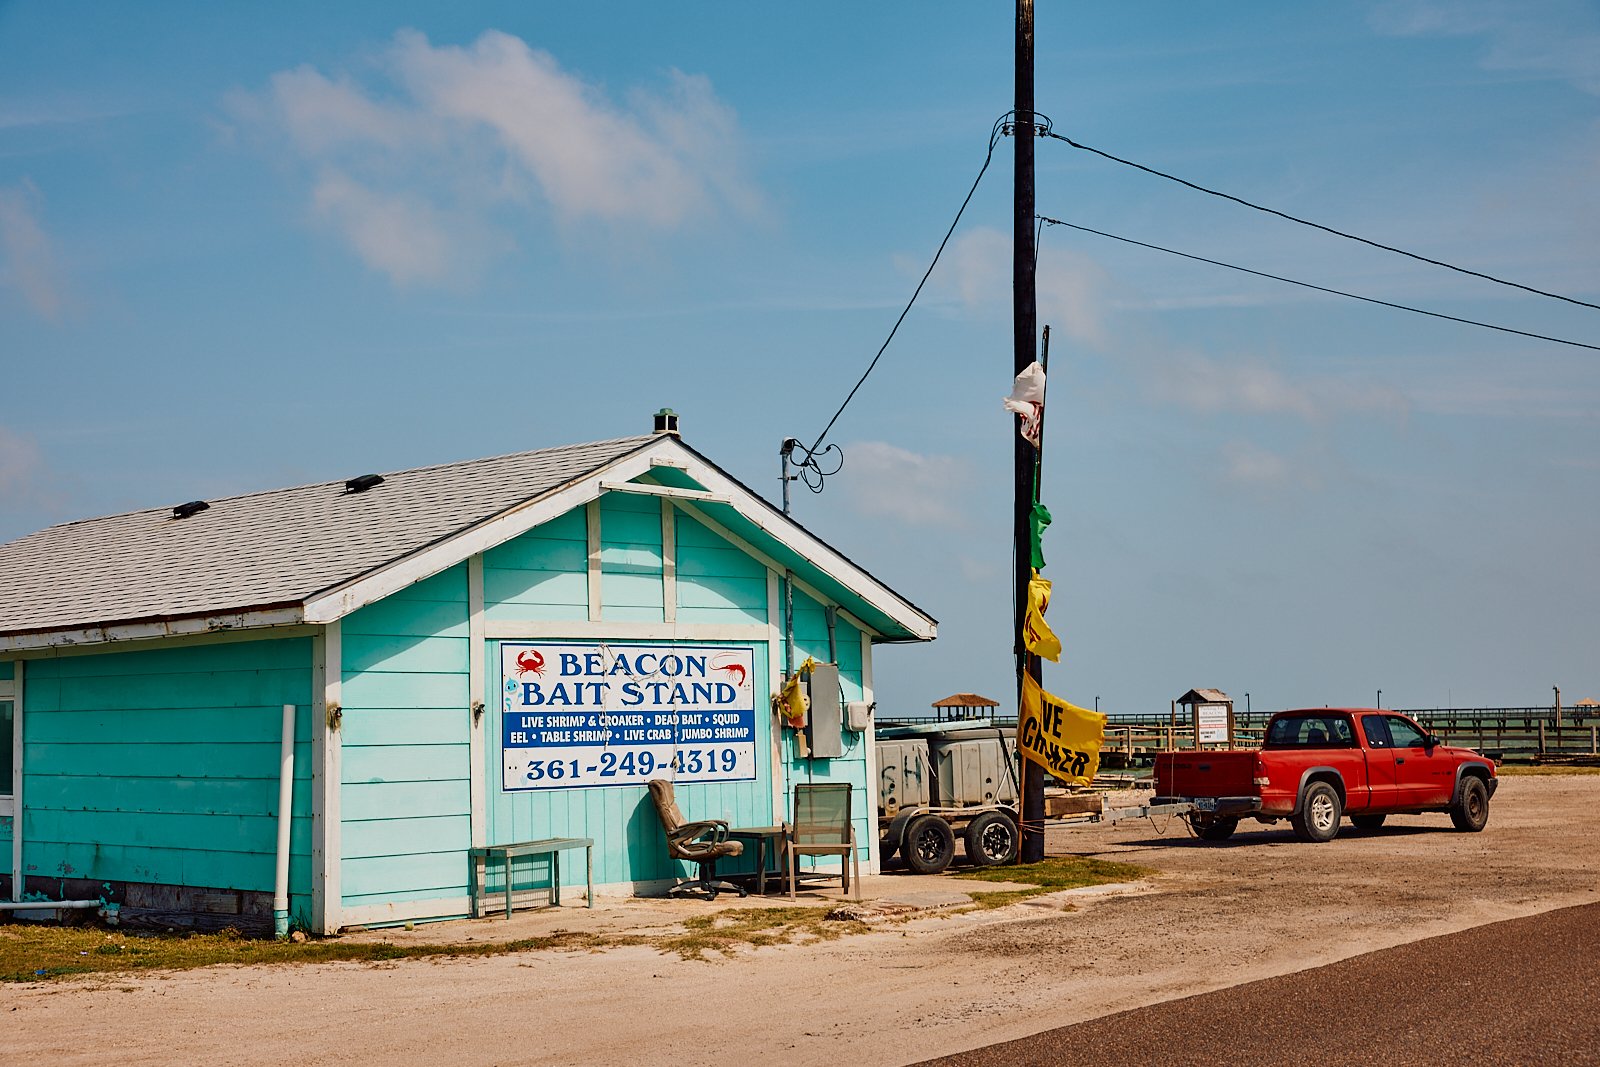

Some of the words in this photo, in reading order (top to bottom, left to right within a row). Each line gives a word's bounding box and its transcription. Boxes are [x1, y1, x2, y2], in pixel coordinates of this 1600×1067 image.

[559, 653, 707, 677] BEACON
[521, 682, 611, 706] BAIT
[621, 682, 737, 706] STAND
[521, 716, 544, 728] LIVE
[546, 715, 586, 728] SHRIMP
[588, 715, 597, 727] &
[599, 714, 644, 727] CROAKER
[654, 714, 680, 726] DEAD
[682, 713, 703, 725] BAIT
[712, 713, 740, 726] SQUID
[510, 731, 529, 744] EEL
[540, 730, 571, 743] TABLE
[573, 729, 613, 742] SHRIMP
[624, 729, 645, 741] LIVE
[647, 728, 672, 740] CRAB
[681, 728, 712, 741] JUMBO
[714, 727, 749, 739] SHRIMP
[526, 748, 737, 781] 361-249-4319
